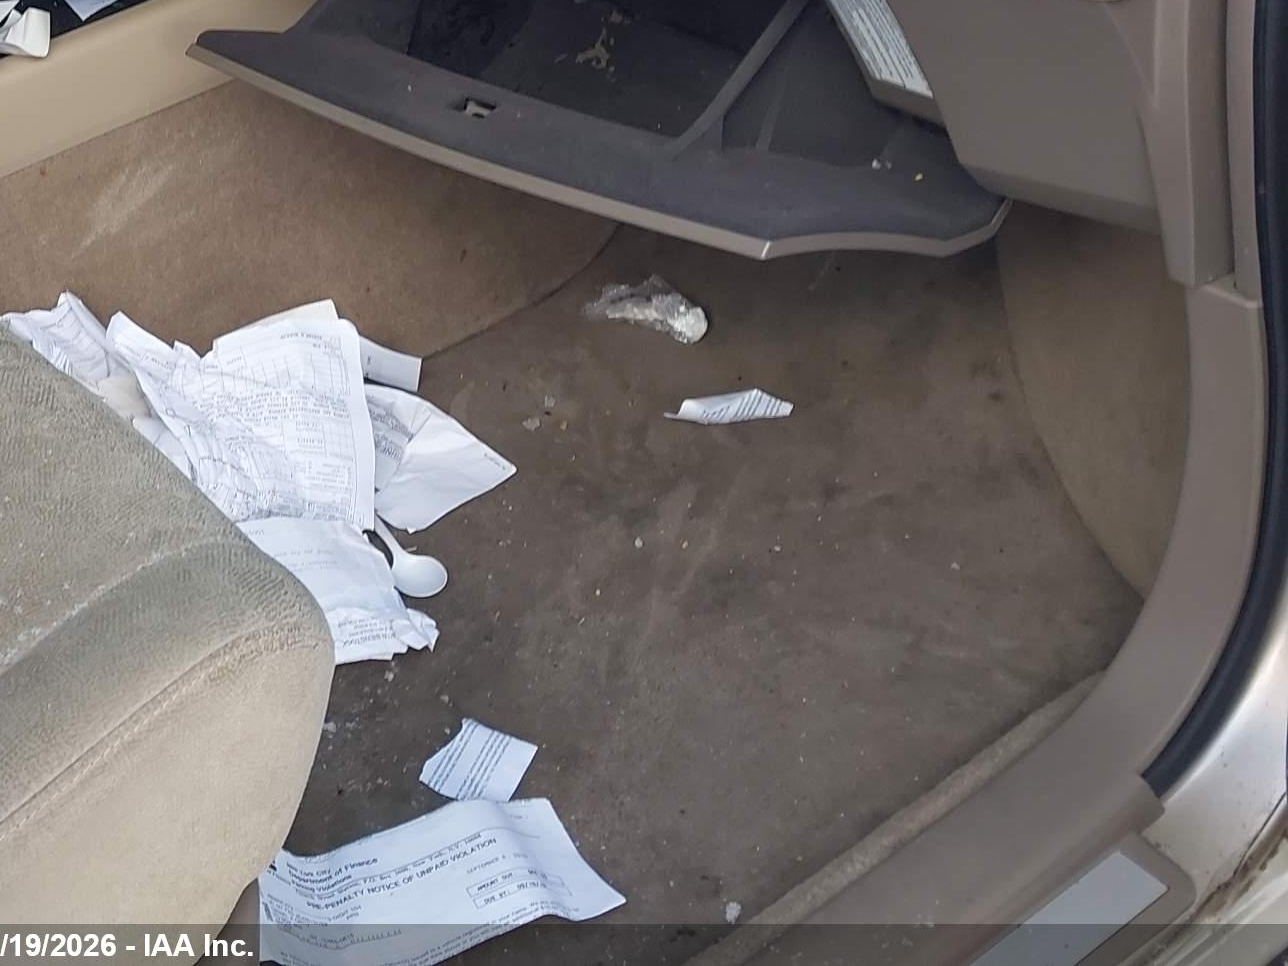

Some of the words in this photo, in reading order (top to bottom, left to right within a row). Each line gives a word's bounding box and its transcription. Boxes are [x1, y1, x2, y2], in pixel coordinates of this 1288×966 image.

[344, 857, 379, 872] Finance
[306, 887, 365, 911] PRE-PENALTY
[367, 879, 400, 895] NOTICE
[402, 875, 413, 885] OF
[416, 859, 449, 879] UNPAID
[450, 837, 498, 862] VIOLATION
[317, 875, 352, 892] Violations
